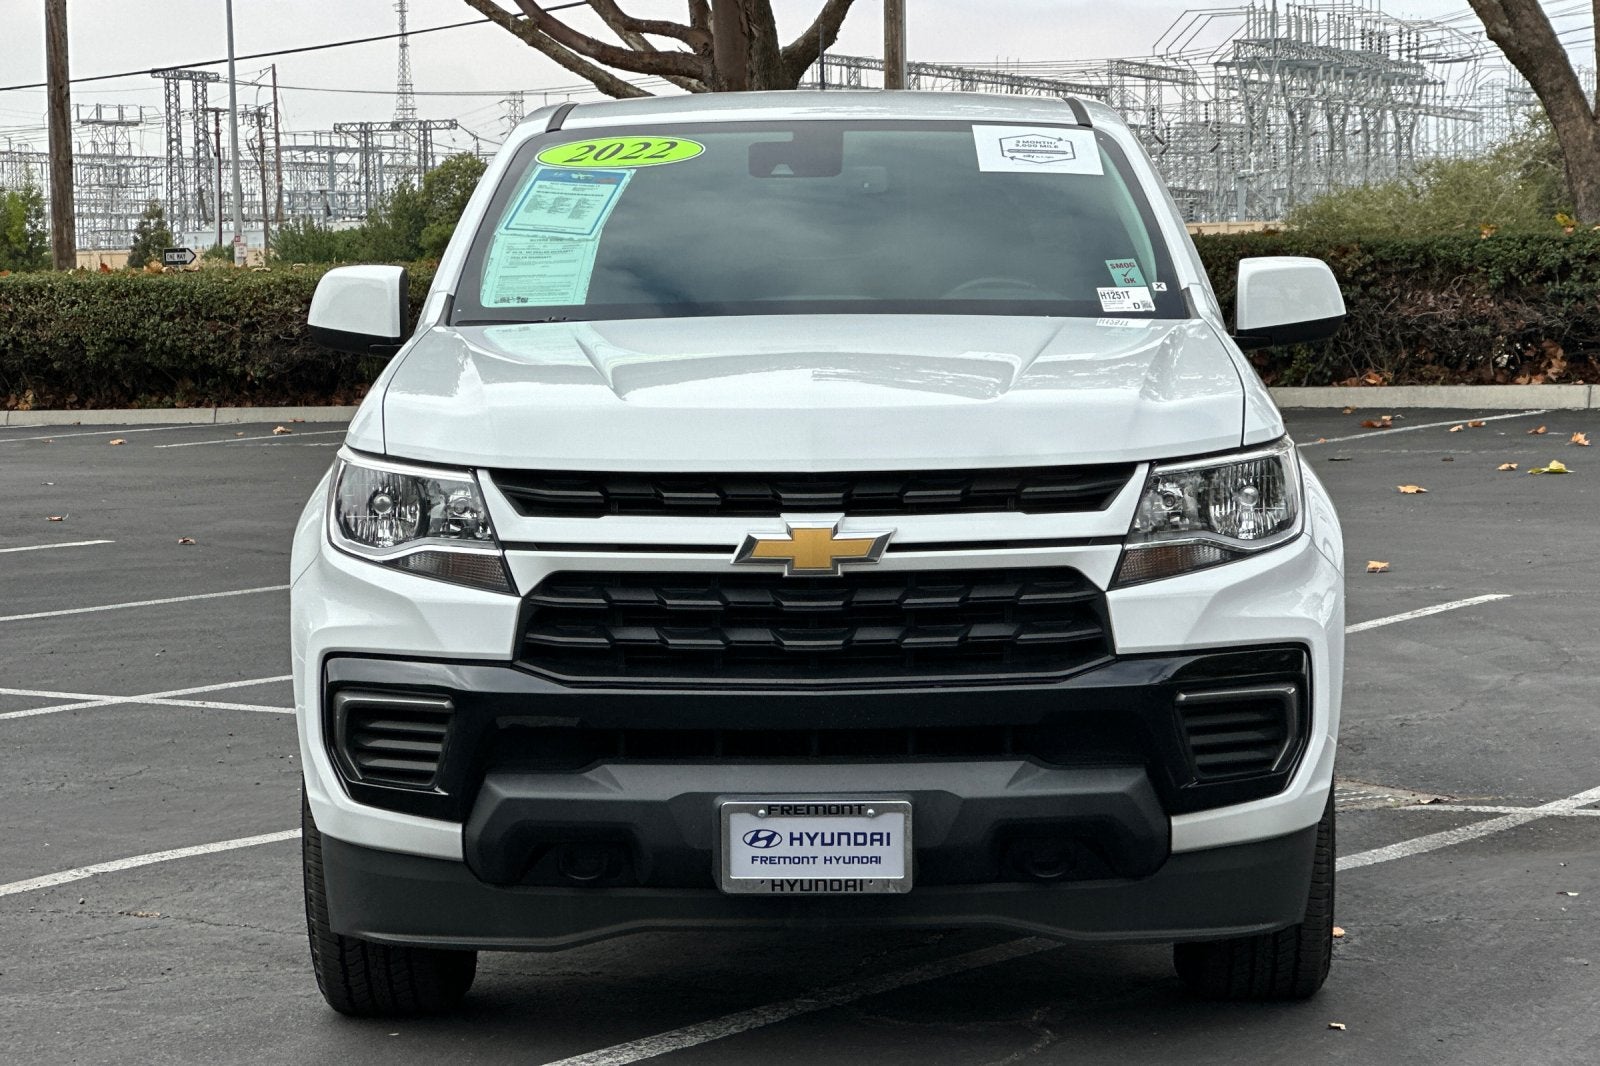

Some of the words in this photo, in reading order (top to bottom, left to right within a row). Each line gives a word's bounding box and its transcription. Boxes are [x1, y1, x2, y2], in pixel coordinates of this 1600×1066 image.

[562, 141, 678, 163] 2022
[1110, 262, 1136, 270] SMOG
[1100, 290, 1131, 300] H1251T
[1133, 302, 1141, 310] D
[767, 803, 866, 816] FREMONT
[789, 831, 891, 847] HYUNDAI
[751, 855, 819, 865] FREMONT
[823, 855, 882, 865] HYUNDAI
[771, 879, 864, 892] HYUNDAI
